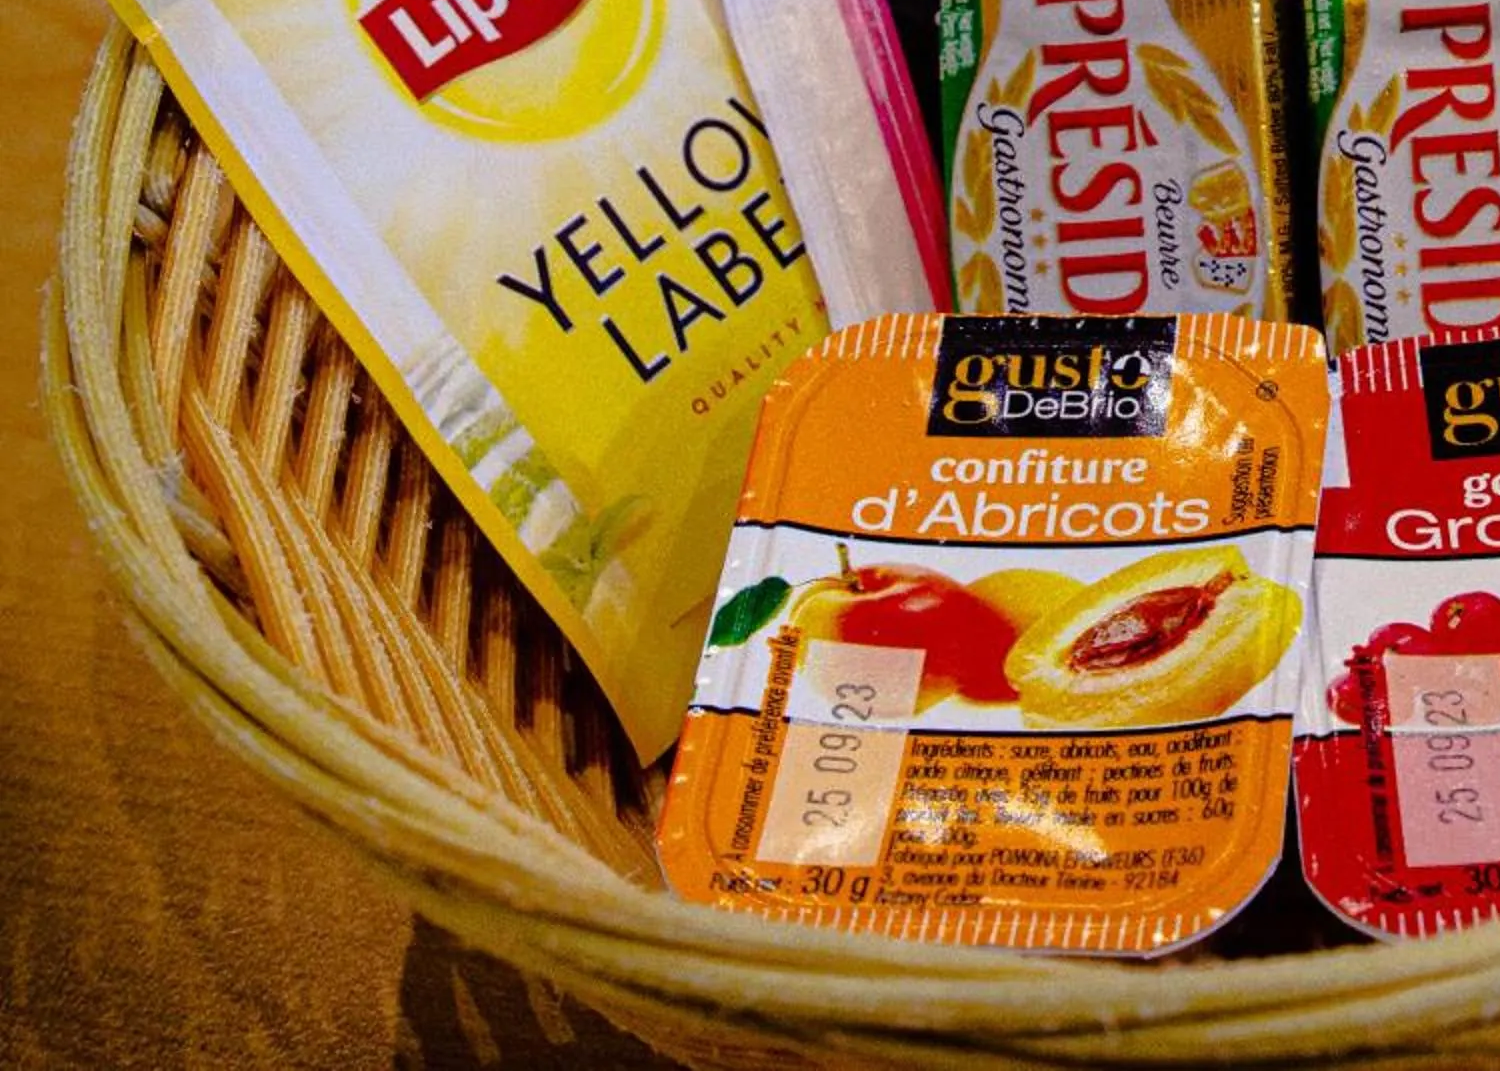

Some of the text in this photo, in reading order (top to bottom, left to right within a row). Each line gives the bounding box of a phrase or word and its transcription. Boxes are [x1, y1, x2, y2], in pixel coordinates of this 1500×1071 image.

[978, 103, 1030, 314] Gastronom
[1153, 178, 1183, 291] Beurre
[1337, 129, 1390, 348] Gastronom
[602, 192, 807, 384] LABE
[691, 317, 803, 416] QUALITY
[943, 344, 1151, 425] gusto
[1002, 391, 1141, 420] DeBrio
[930, 448, 1148, 485] confiture
[851, 487, 1211, 539] d'Abricots
[742, 758, 769, 775] de
[801, 683, 877, 828] 25 09 23
[912, 737, 994, 761] Ingrédients
[1172, 756, 1192, 777] de
[1421, 689, 1484, 825] 25 09 23
[1056, 785, 1078, 804] de
[1127, 787, 1163, 807] pour
[1218, 772, 1239, 793] de
[1103, 812, 1125, 827] en
[1202, 797, 1235, 820] 60g
[801, 865, 845, 896] 30
[850, 875, 871, 902] g
